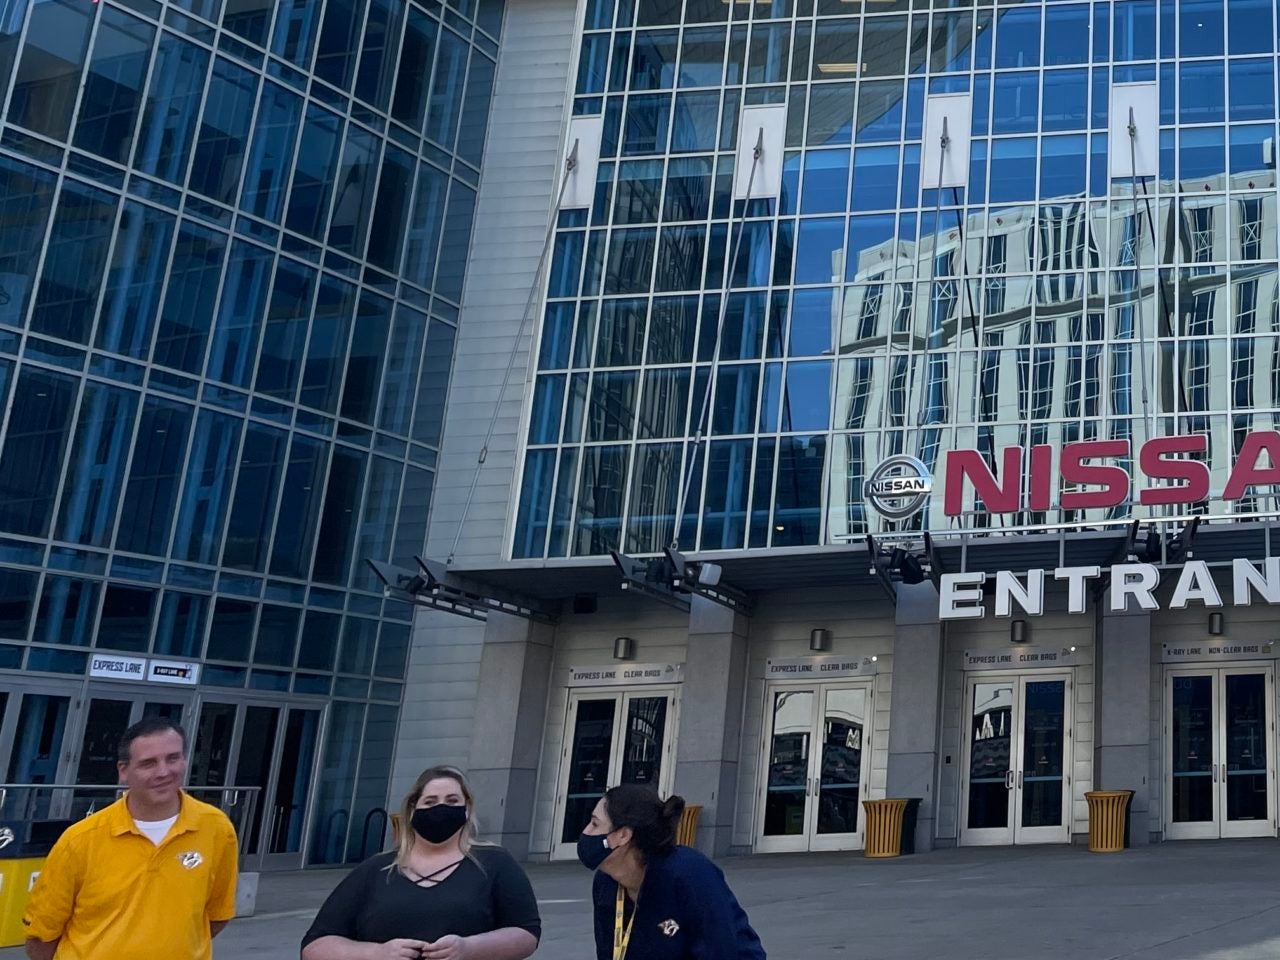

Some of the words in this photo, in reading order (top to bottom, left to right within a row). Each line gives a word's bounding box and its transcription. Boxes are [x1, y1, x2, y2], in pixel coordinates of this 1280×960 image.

[870, 480, 925, 493] NISSAN
[1187, 647, 1202, 655] LANE
[968, 655, 995, 664] EXPRESS
[997, 654, 1012, 663] LANE
[1019, 654, 1039, 662] CLEAR
[92, 660, 124, 672] EXPRESS
[124, 663, 142, 674] LANE
[770, 664, 797, 673] EXPRESS
[798, 664, 813, 672] LANE
[820, 664, 841, 672] CLEAR
[573, 672, 600, 680] EXPRESS
[601, 671, 616, 679] LANE
[623, 670, 643, 679] CLEAR
